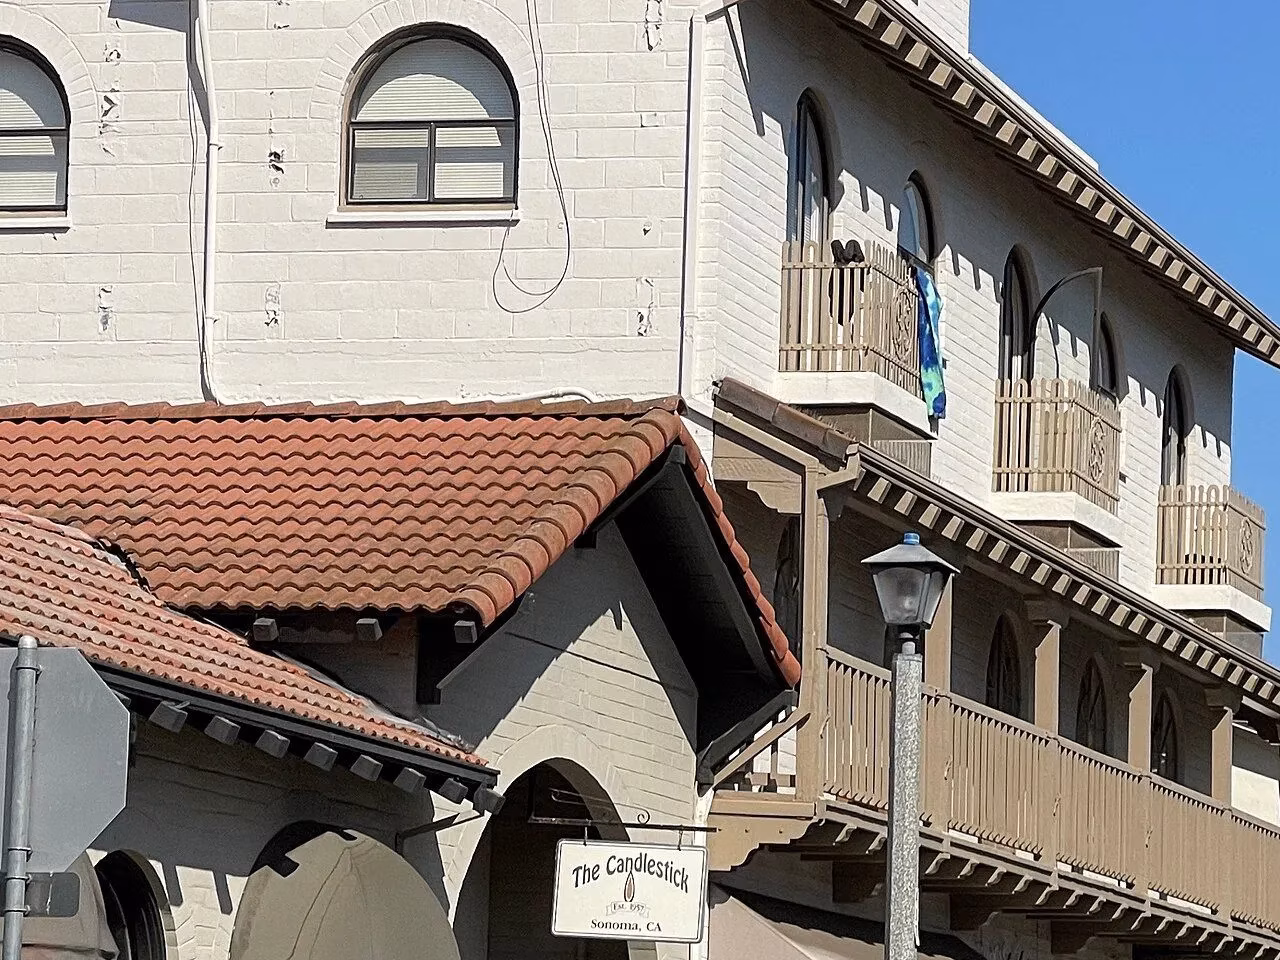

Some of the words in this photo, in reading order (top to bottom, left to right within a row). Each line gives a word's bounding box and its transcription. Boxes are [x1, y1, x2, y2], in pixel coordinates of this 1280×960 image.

[572, 863, 600, 888] The
[606, 852, 690, 894] Candlestick
[590, 919, 642, 932] Sonoma,
[646, 921, 662, 932] CA
